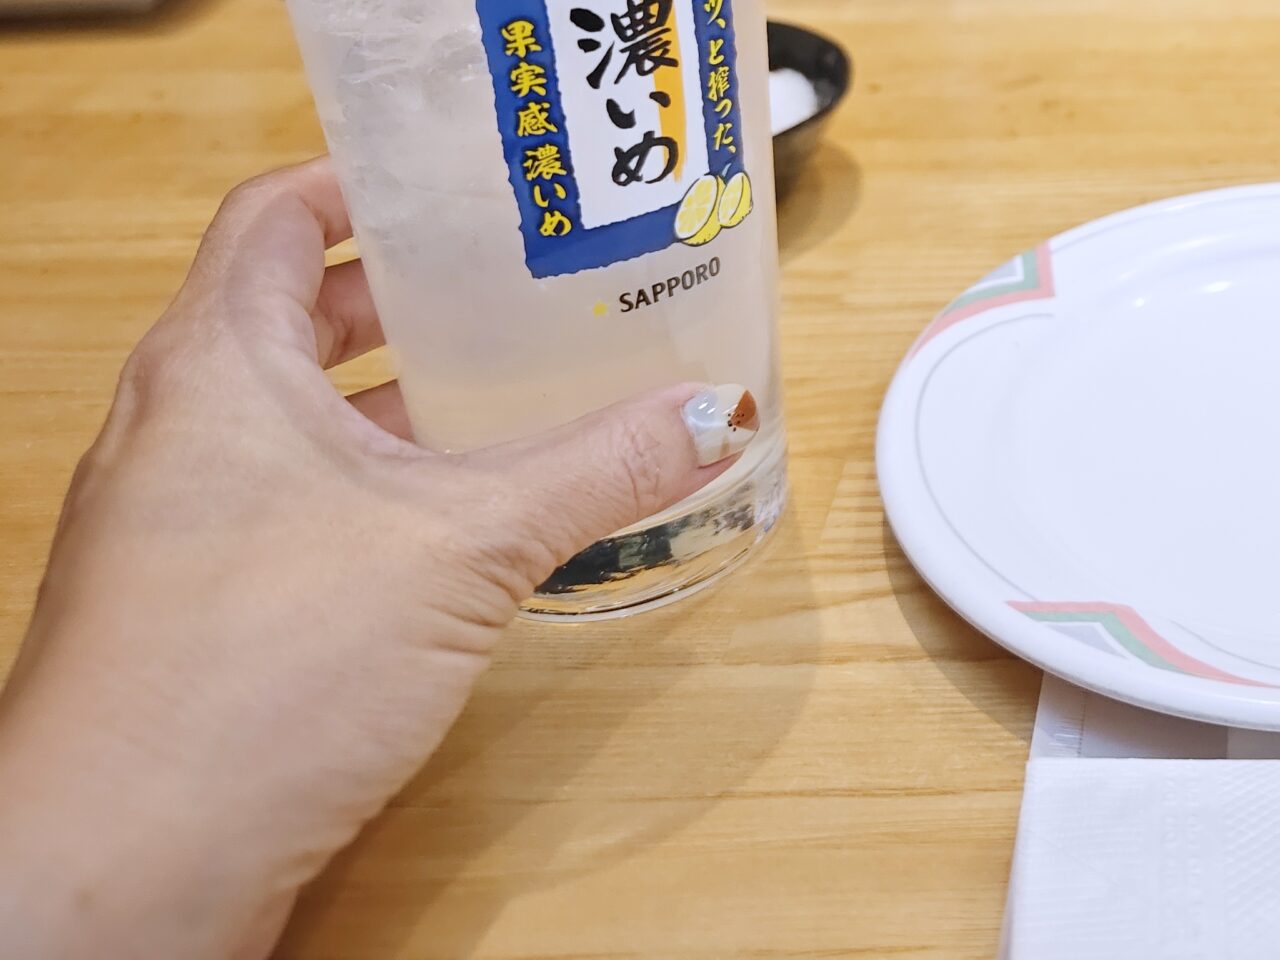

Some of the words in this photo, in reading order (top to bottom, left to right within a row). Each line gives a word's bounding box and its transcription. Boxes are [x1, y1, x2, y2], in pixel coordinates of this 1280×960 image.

[499, 20, 574, 238] 果実感濃いめ
[618, 256, 721, 313] SAPPORO
